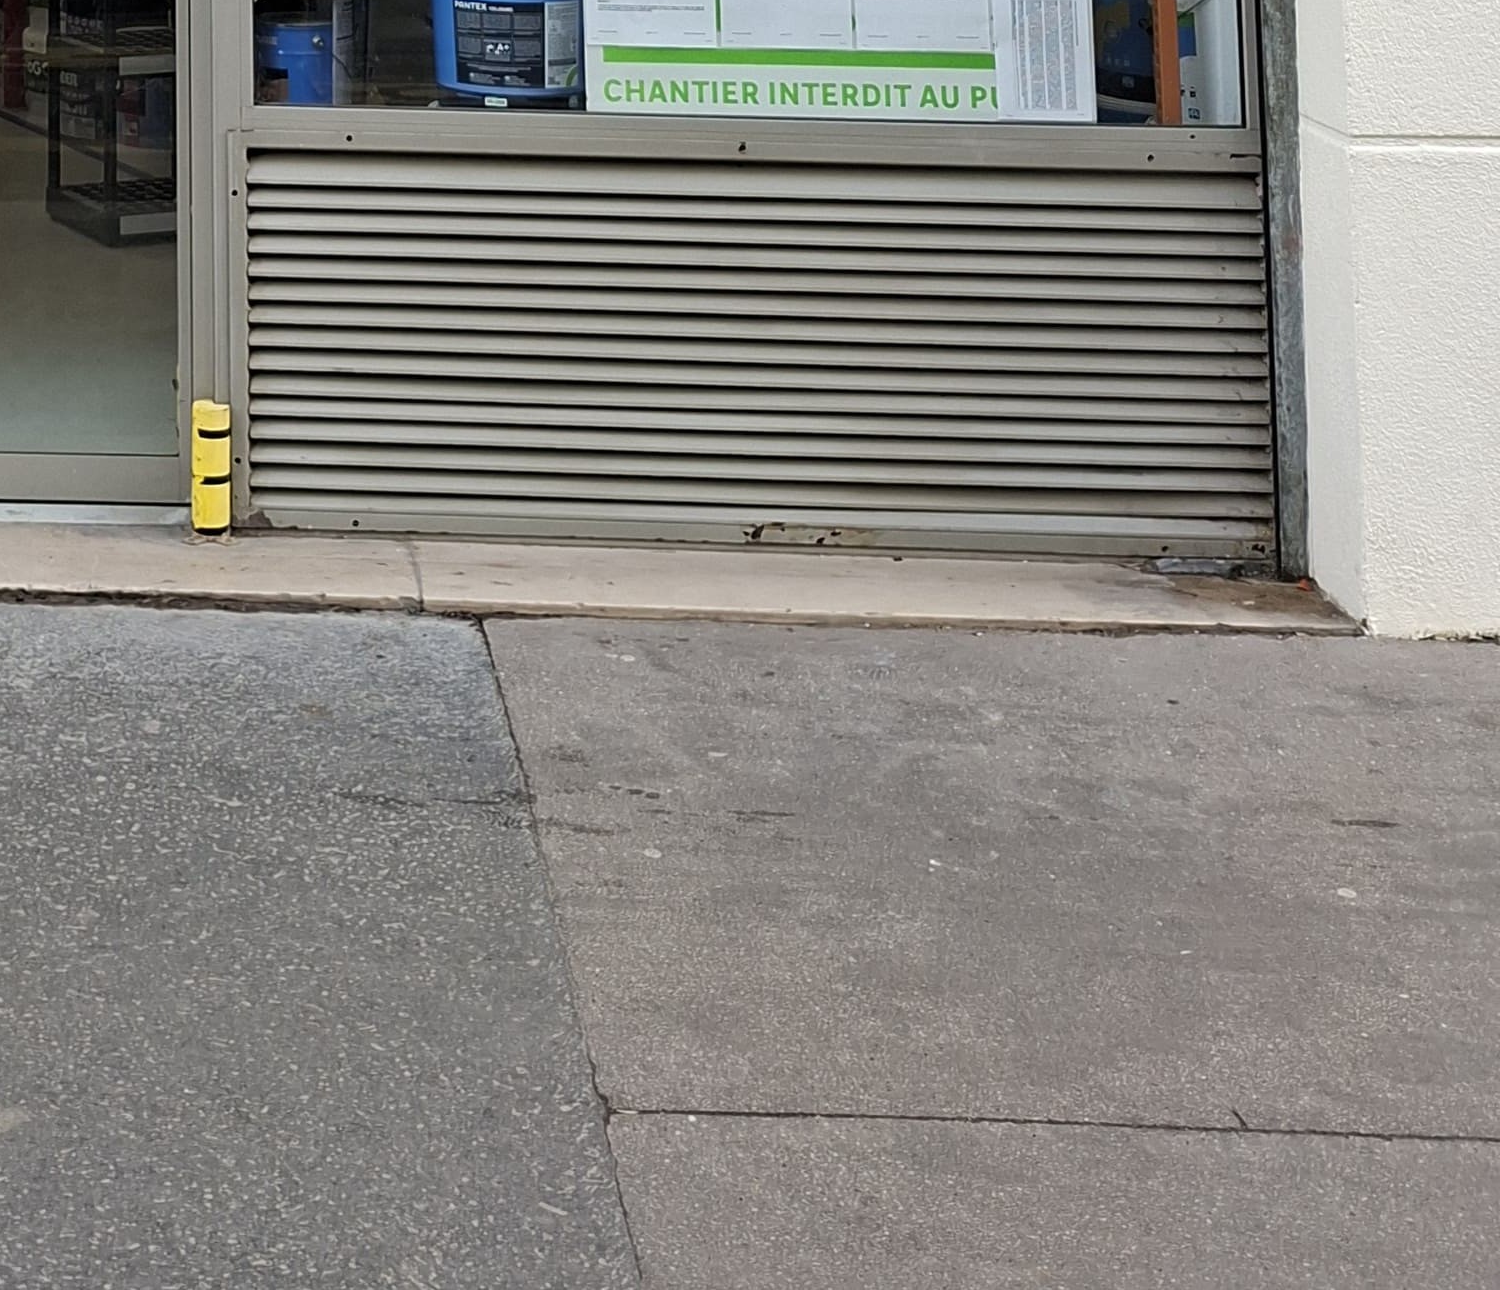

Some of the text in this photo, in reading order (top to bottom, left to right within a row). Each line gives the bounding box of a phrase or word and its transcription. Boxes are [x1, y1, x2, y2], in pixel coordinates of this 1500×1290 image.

[603, 78, 759, 105] CHANTIER
[769, 80, 912, 107] INTERDIT
[919, 85, 960, 109] AU
